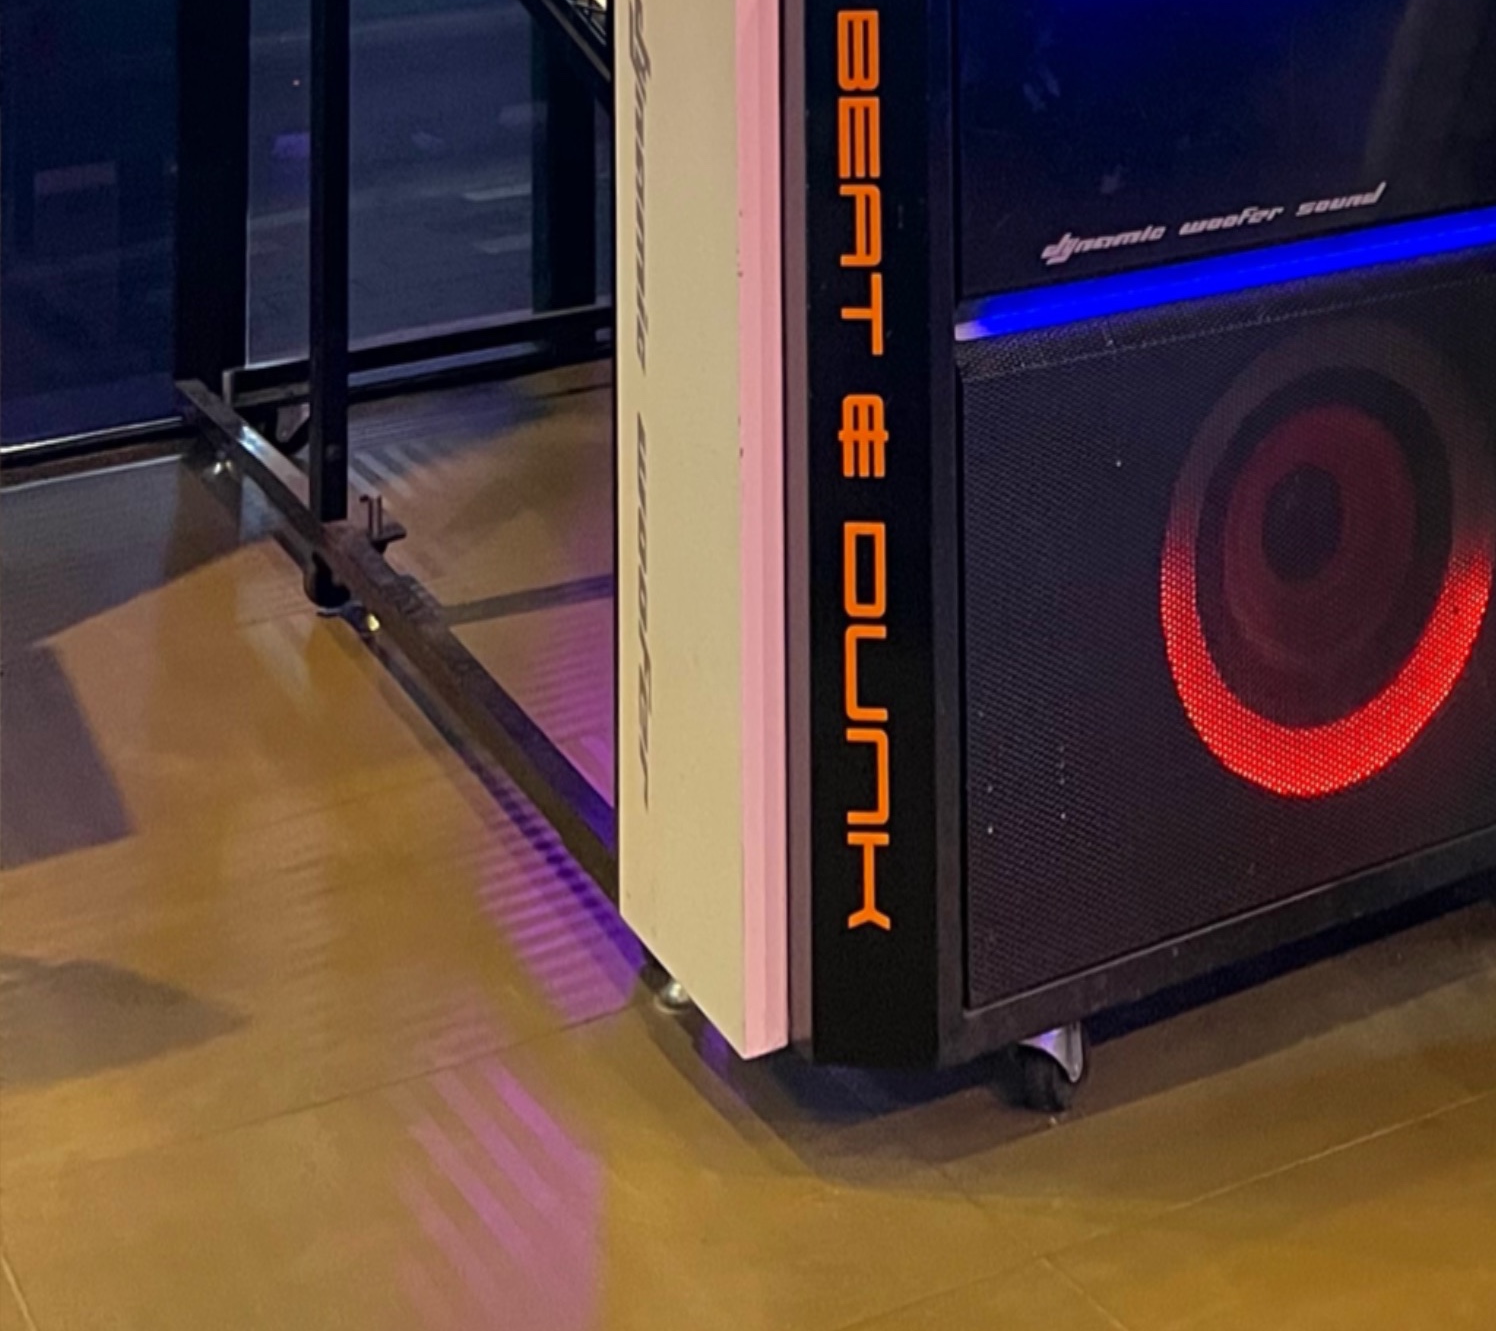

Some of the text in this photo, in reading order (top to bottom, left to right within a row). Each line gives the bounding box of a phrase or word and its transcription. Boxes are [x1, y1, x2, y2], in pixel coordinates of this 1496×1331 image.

[836, 8, 885, 357] BEAT
[1039, 180, 1387, 267] dynamic woofer sound
[842, 520, 892, 932] DUNK
